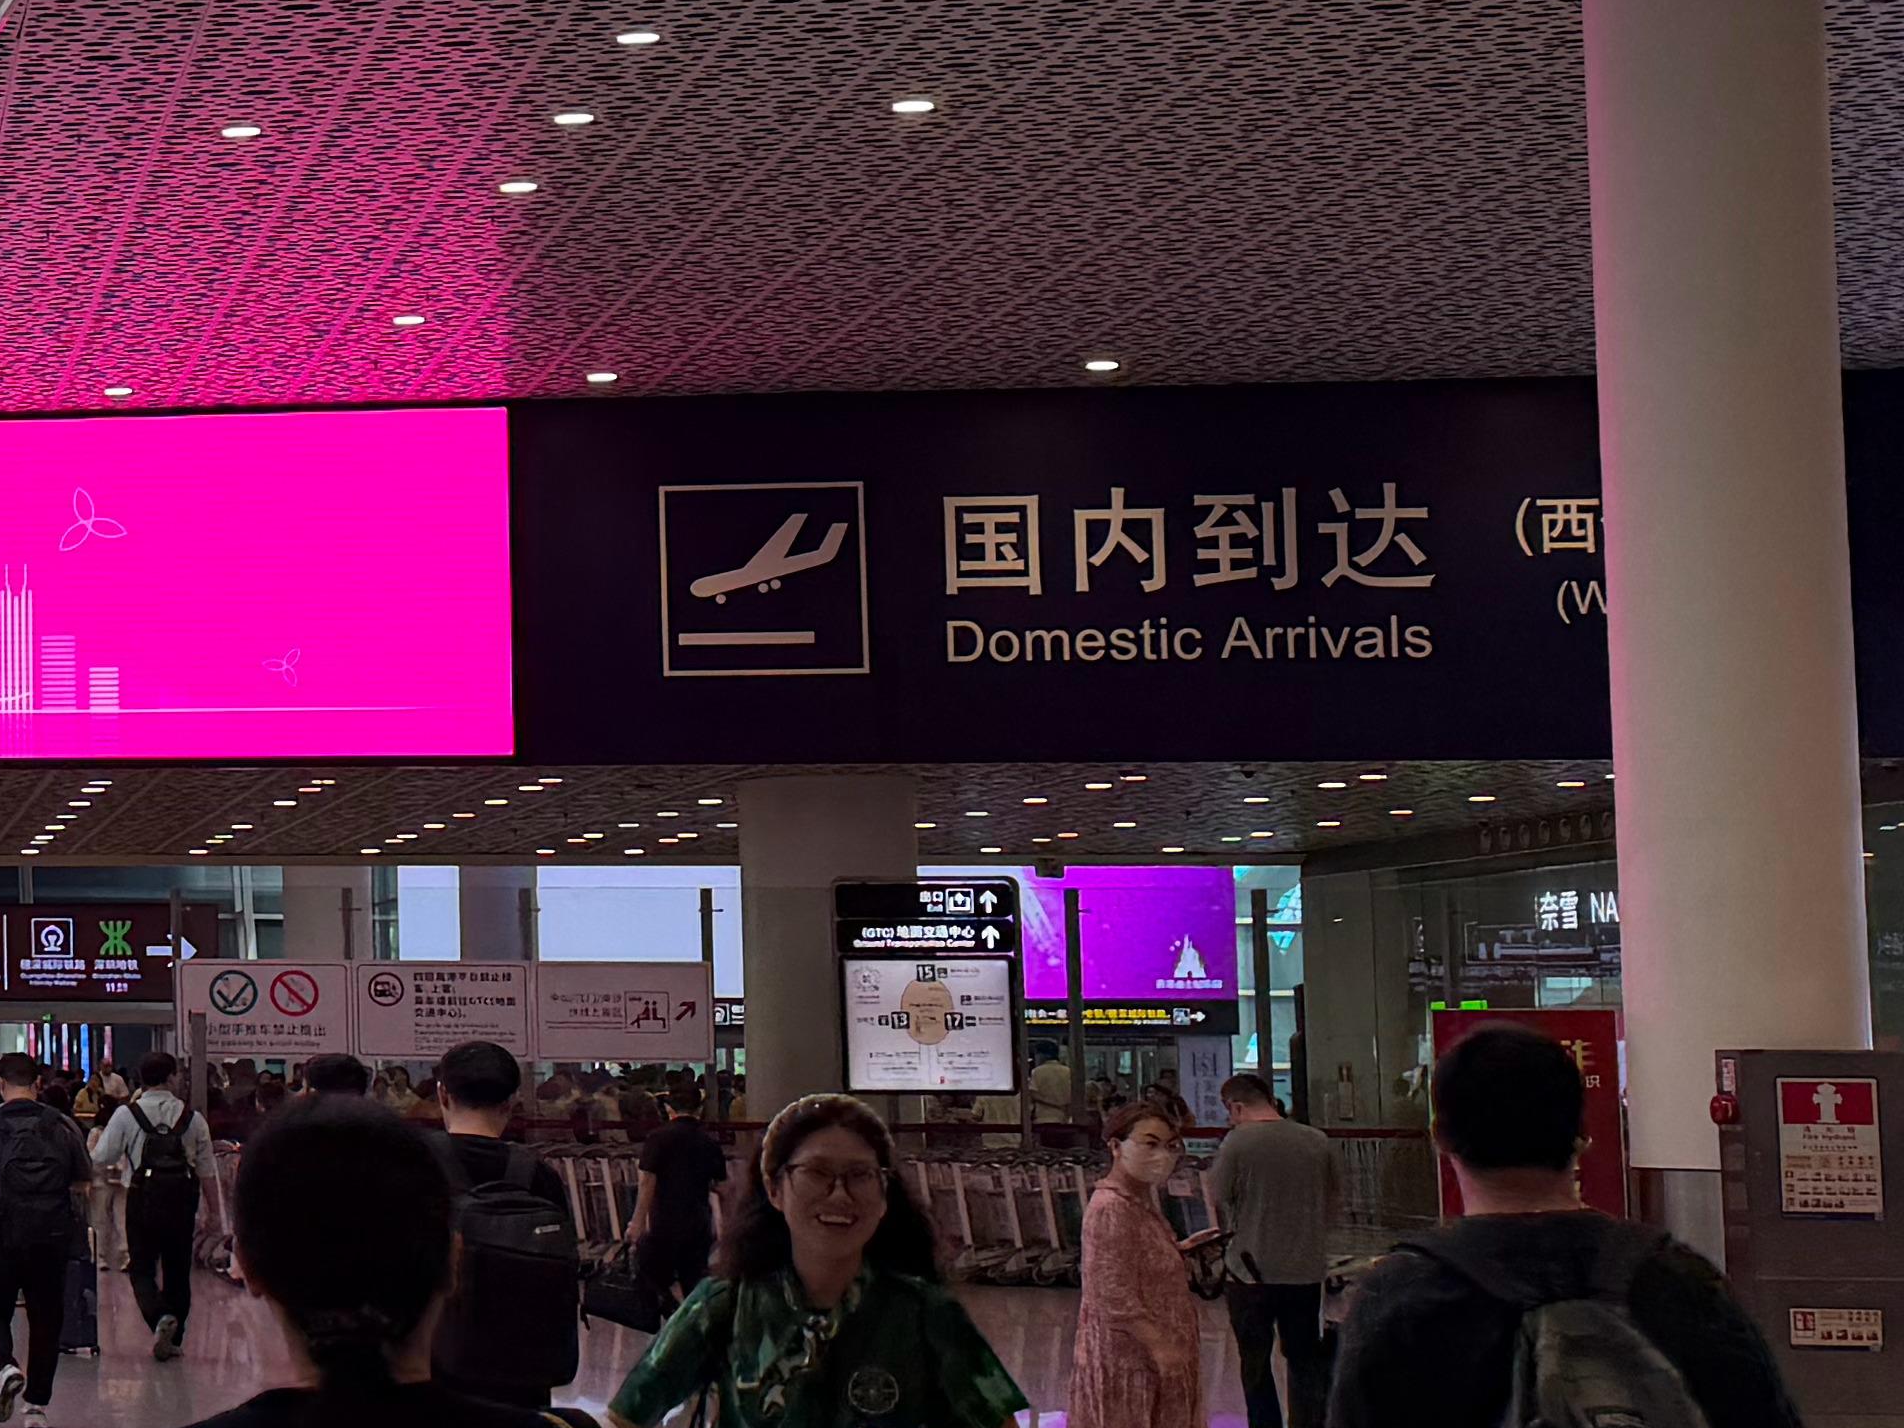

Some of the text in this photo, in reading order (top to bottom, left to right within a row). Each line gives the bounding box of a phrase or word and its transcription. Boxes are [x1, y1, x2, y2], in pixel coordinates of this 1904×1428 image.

[943, 483, 1435, 596] 国内到达
[1514, 496, 1604, 557] (西
[1556, 579, 1607, 625] (W
[945, 614, 1434, 663] Domestic Arrivals
[1538, 890, 1579, 931] 奈雪
[917, 965, 935, 981] 15
[892, 1013, 909, 1028] 13
[945, 1013, 962, 1029] 17
